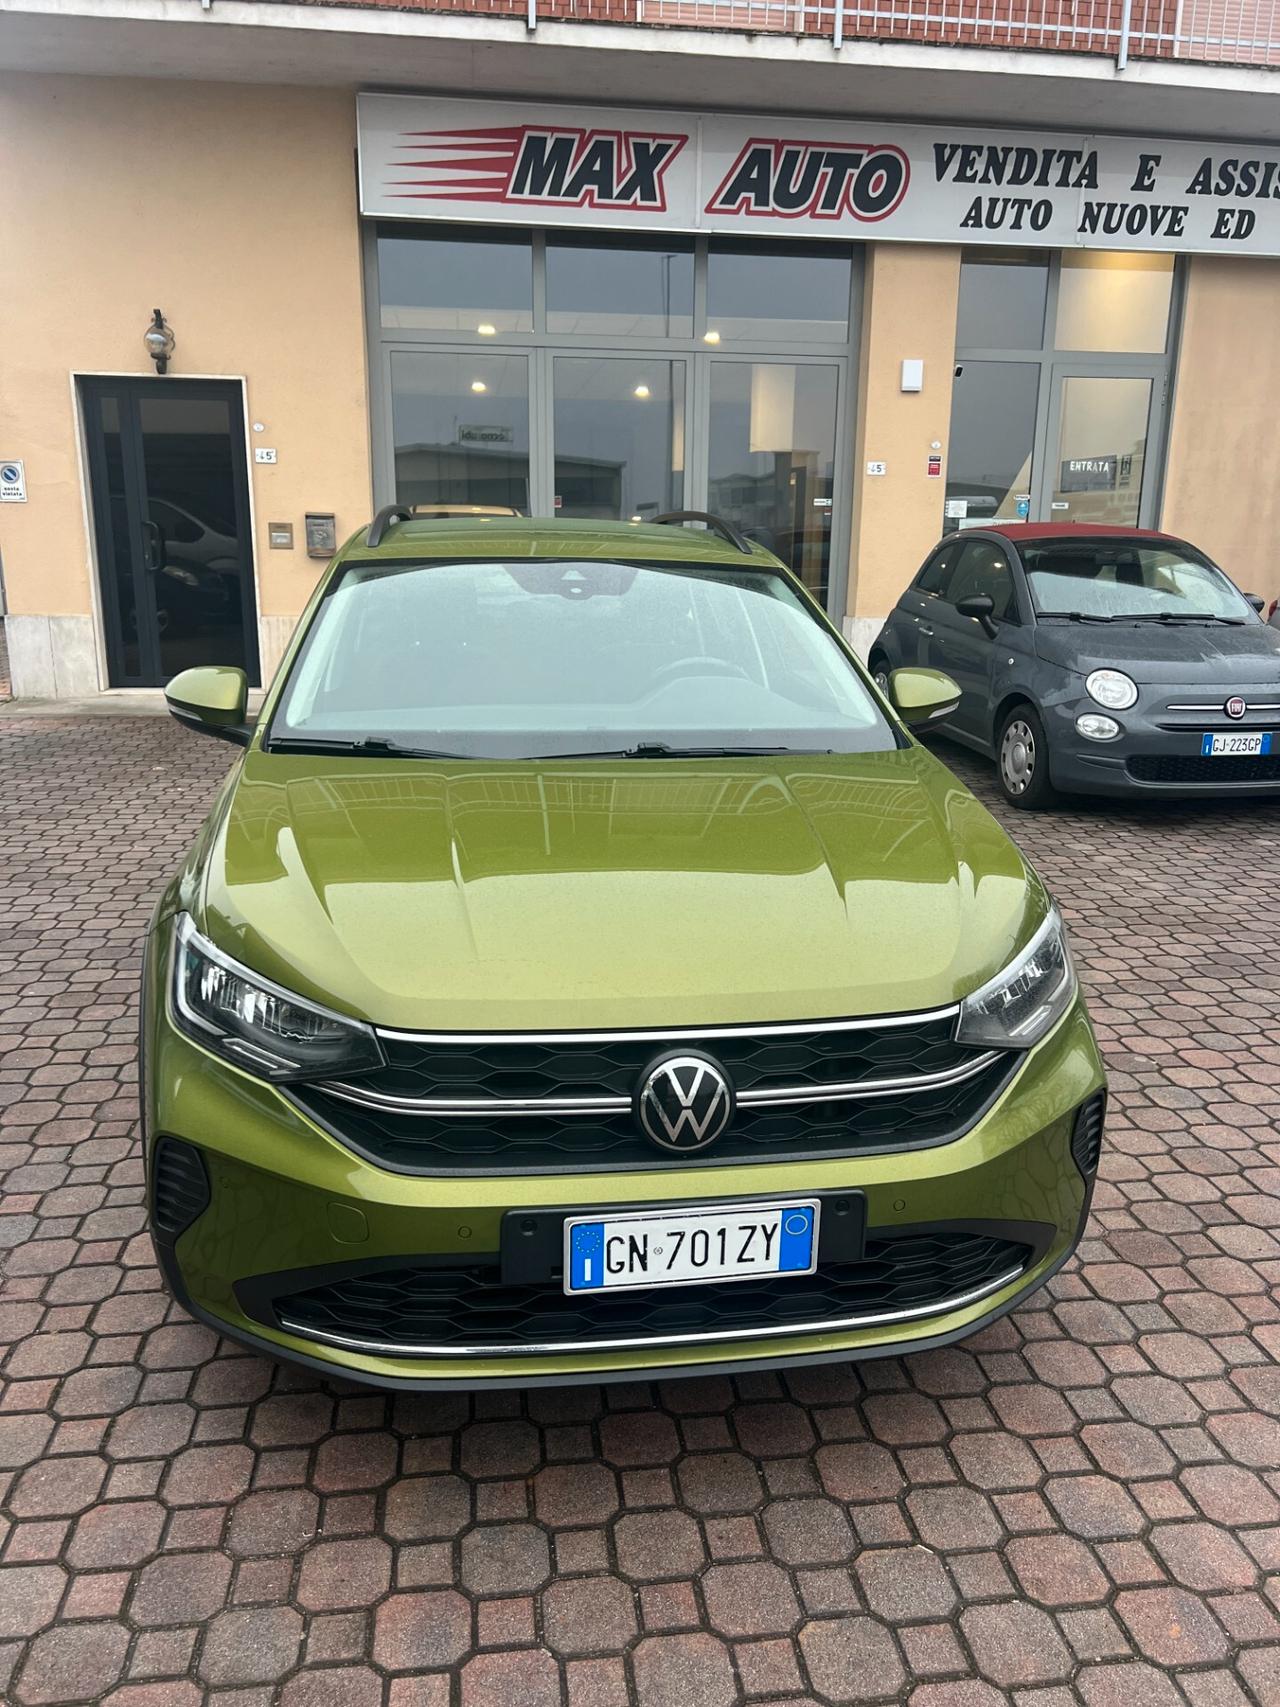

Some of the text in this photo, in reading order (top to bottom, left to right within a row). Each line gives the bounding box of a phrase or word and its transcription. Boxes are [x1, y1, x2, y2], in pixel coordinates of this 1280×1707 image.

[505, 127, 909, 220] MAX AUTO
[933, 142, 1099, 189] VENDITA
[1130, 154, 1162, 192] E
[960, 195, 1256, 240] AUTO NUOVE ED
[1070, 461, 1109, 473] ENTRATA
[1231, 702, 1242, 713] FIAT
[606, 1222, 779, 1275] GN 701ZY
